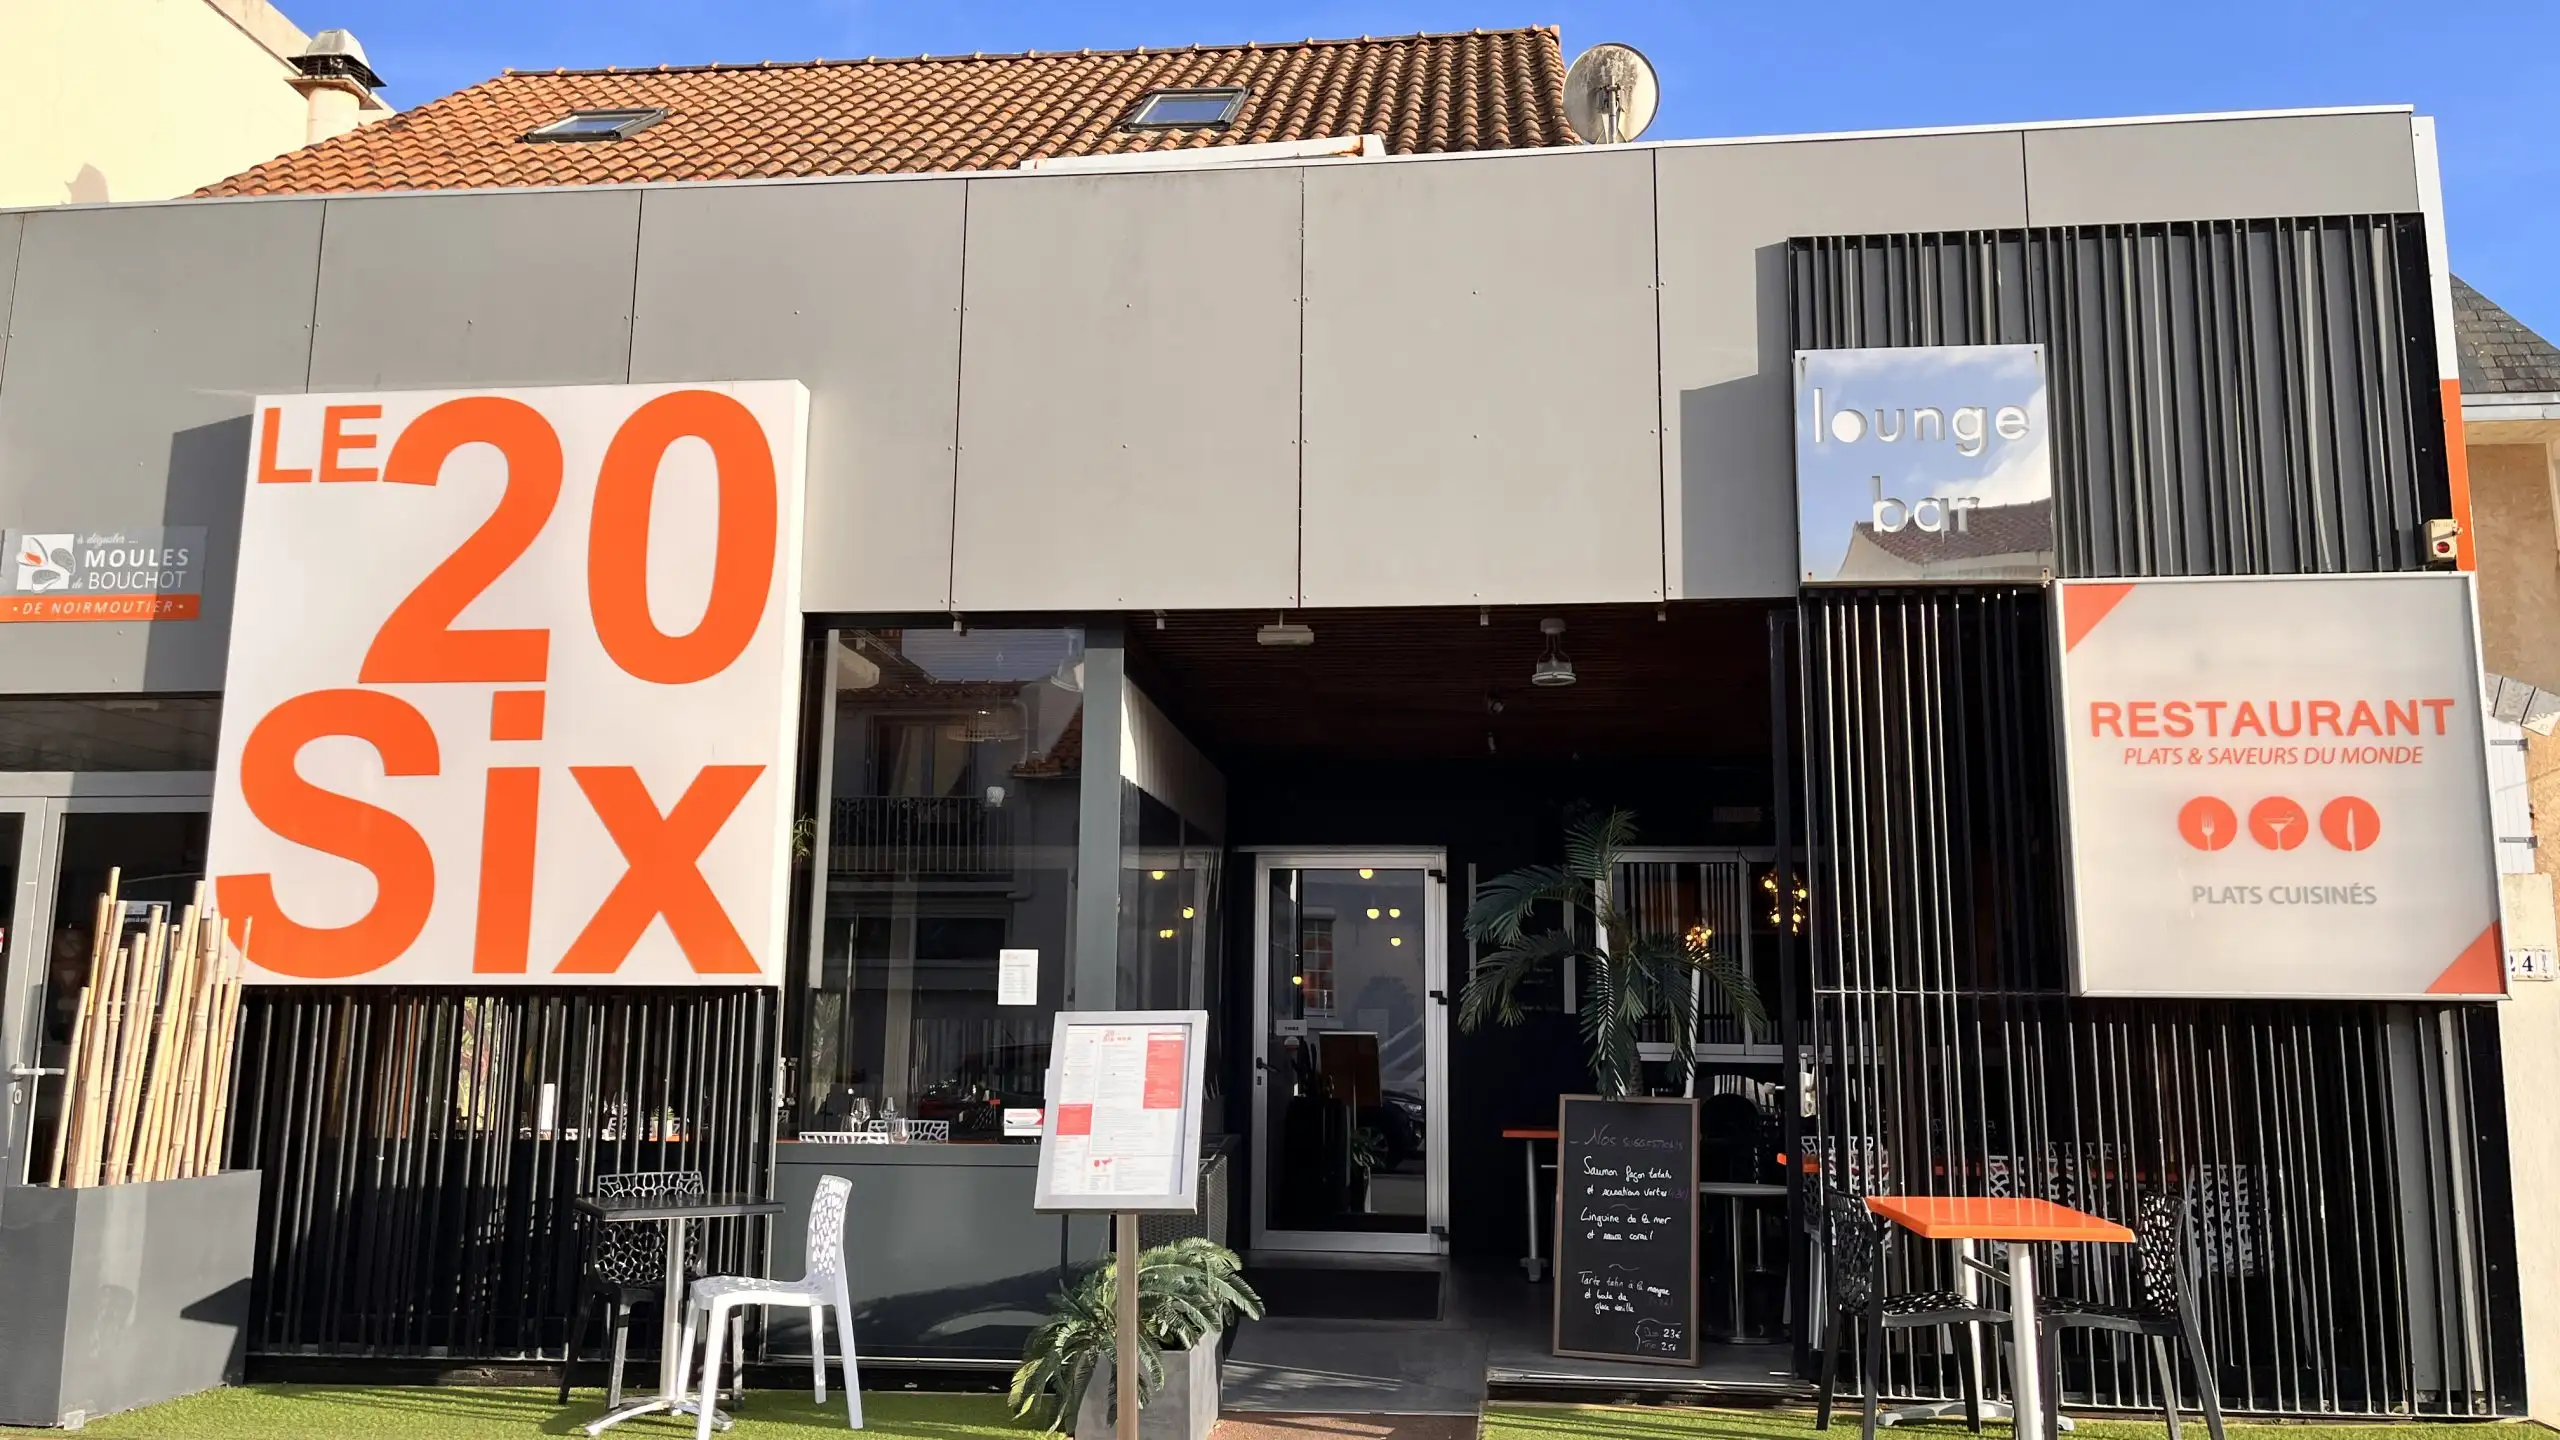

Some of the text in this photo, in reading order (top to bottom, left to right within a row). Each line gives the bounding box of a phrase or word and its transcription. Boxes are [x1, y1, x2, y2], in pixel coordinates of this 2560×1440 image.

[1813, 387, 2030, 457] lounge
[1871, 475, 1981, 533] bar
[258, 389, 778, 685] LE 20
[85, 549, 189, 568] MOULES
[88, 570, 187, 590] BOUCHOT
[22, 600, 174, 615] DE NOIRMOUTIER
[2090, 699, 2455, 738] RESTAURANT
[2124, 746, 2424, 765] PLATS & SAVEURS DU MONDE
[216, 688, 768, 979] Six
[2192, 881, 2377, 905] PLATS CUISINÉS
[1583, 1156, 1618, 1176] Saumon
[1625, 1165, 1646, 1183] façon
[1587, 1185, 1595, 1195] et
[1580, 1206, 1620, 1228] Linguine
[1653, 1216, 1672, 1225] mer
[1587, 1230, 1596, 1239] et
[1578, 1271, 1601, 1286] Tarte
[1584, 1288, 1592, 1299] et
